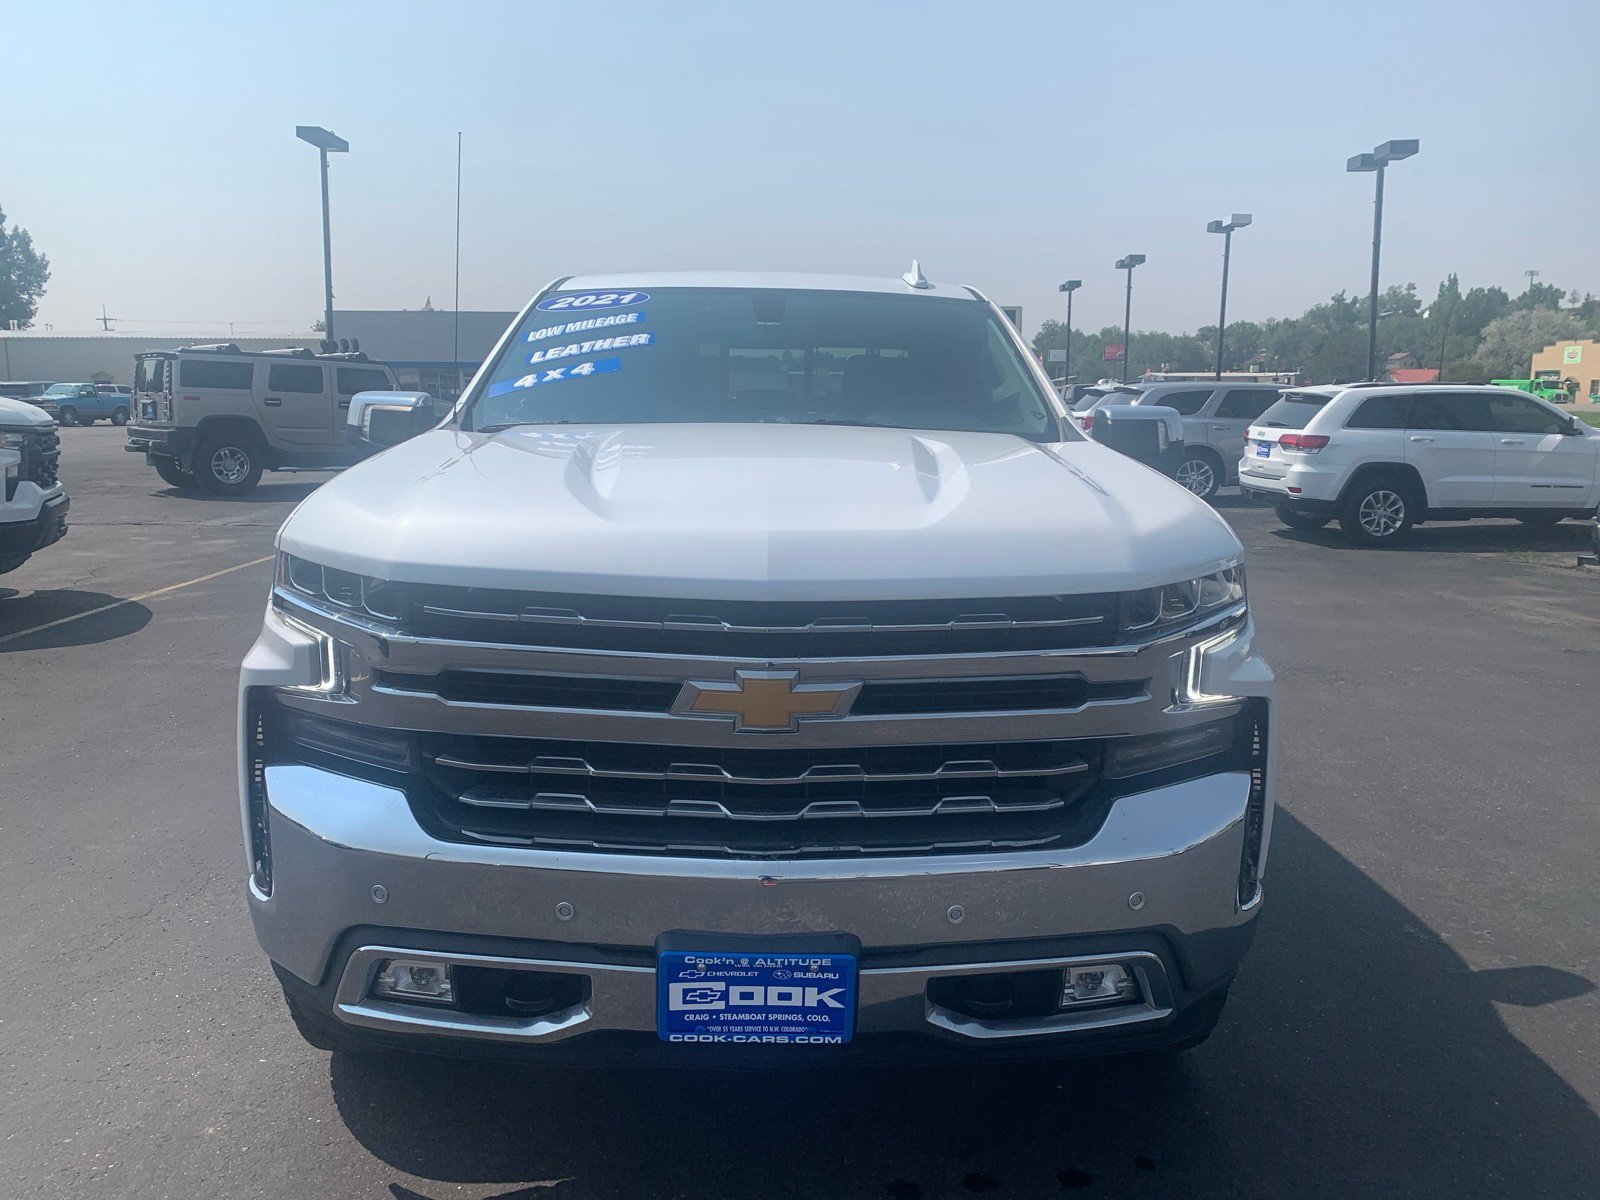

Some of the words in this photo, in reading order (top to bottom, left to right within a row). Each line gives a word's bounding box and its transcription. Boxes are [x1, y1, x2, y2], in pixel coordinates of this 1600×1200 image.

[547, 293, 638, 310] 2021
[527, 325, 565, 342] LOW
[565, 312, 638, 334] MILEAGE
[530, 333, 651, 364] LEATHER
[514, 373, 538, 388] 4
[570, 362, 595, 376] 4
[754, 958, 831, 966] ALTITUDE
[793, 971, 839, 979] SUBARU
[669, 982, 846, 1011] COOK
[684, 1014, 710, 1022] CRAIG
[719, 1013, 766, 1021] STEAMBOAT
[768, 1013, 805, 1022] SPRINGS,
[806, 1014, 831, 1022] COLO.
[669, 1034, 842, 1044] COOK-CARS.COM
